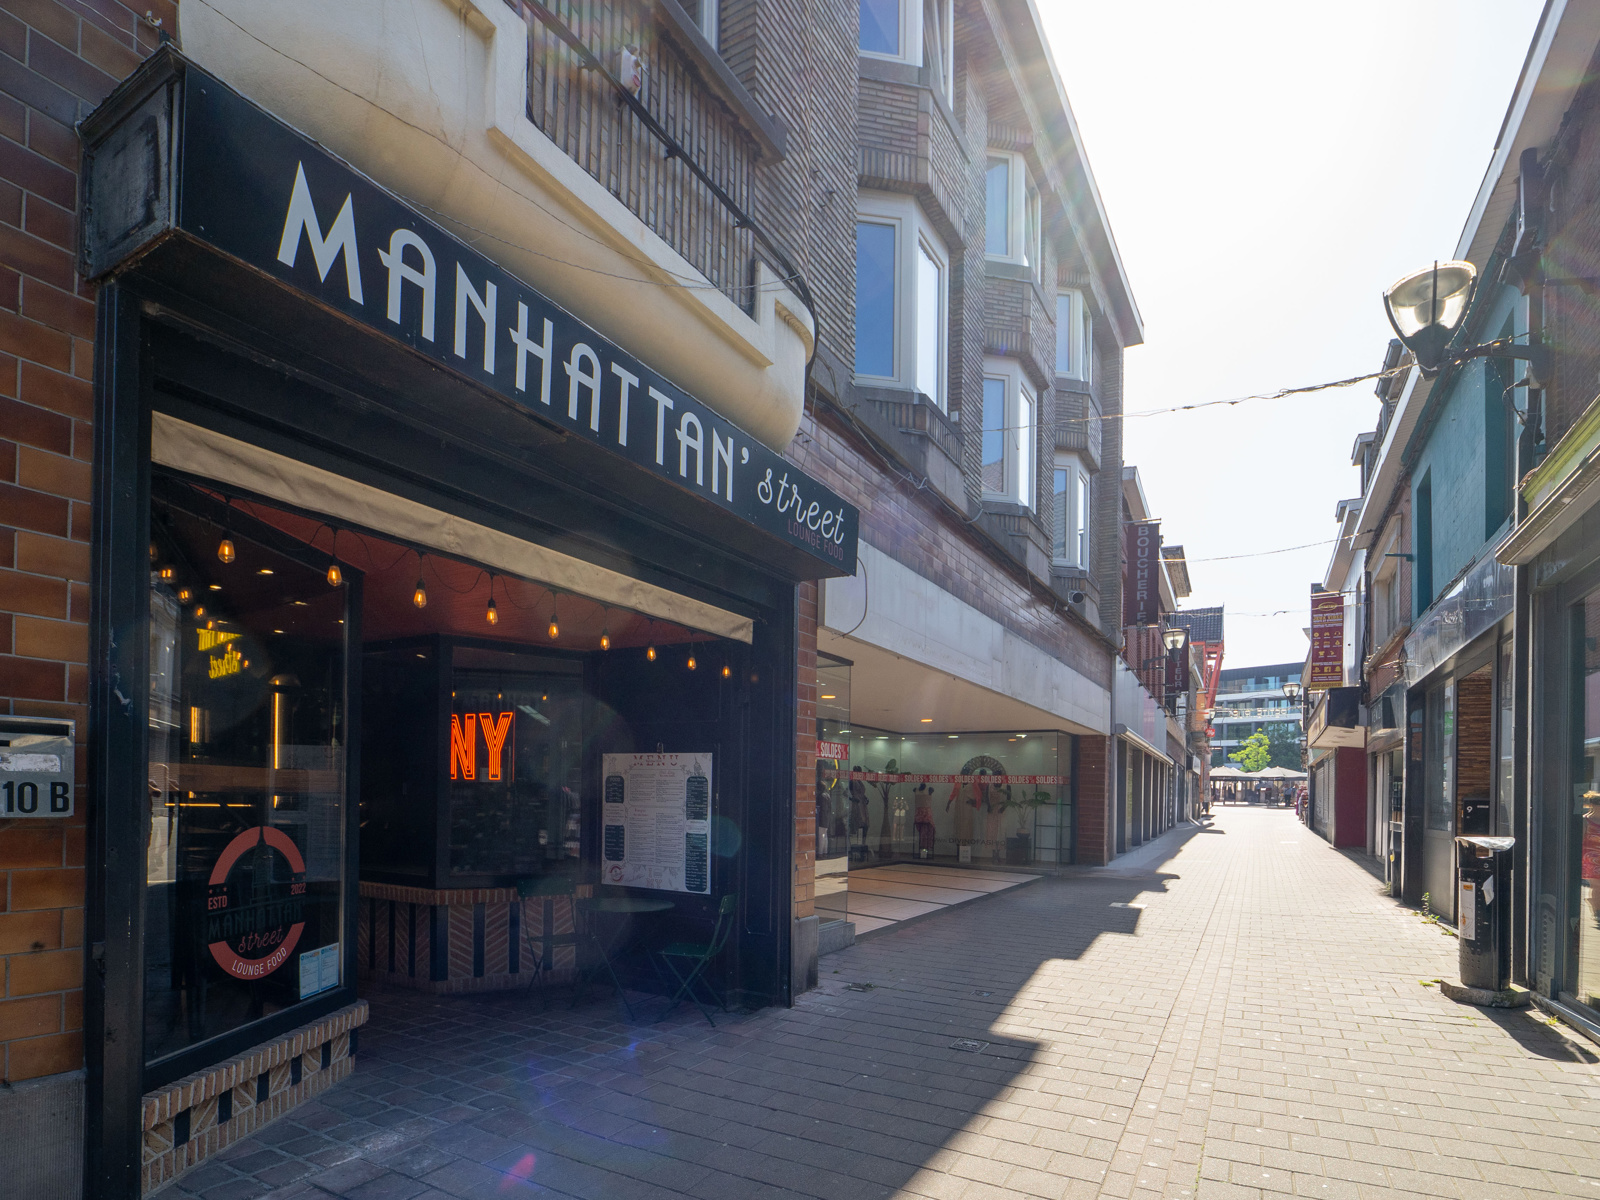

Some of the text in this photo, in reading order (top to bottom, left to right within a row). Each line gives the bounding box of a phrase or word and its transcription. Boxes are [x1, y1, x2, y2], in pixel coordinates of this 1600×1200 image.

[757, 467, 845, 545] street
[787, 518, 844, 561] LOUNGE FOOD
[450, 711, 513, 780] NY
[820, 741, 841, 759] SOLDES
[904, 775, 923, 783] SOLDES
[929, 775, 949, 783] SOLDES
[955, 775, 974, 783] SOLDES
[981, 775, 1002, 784] SOLDES
[1008, 776, 1029, 784] SOLDES
[1036, 776, 1057, 784] SOLDES
[2, 781, 70, 813] 10 B
[1466, 805, 1473, 813] 9
[207, 895, 228, 910] ESTD
[290, 883, 306, 896] 2022
[238, 925, 283, 953] street
[231, 946, 287, 976] LOUNGE FOOD
